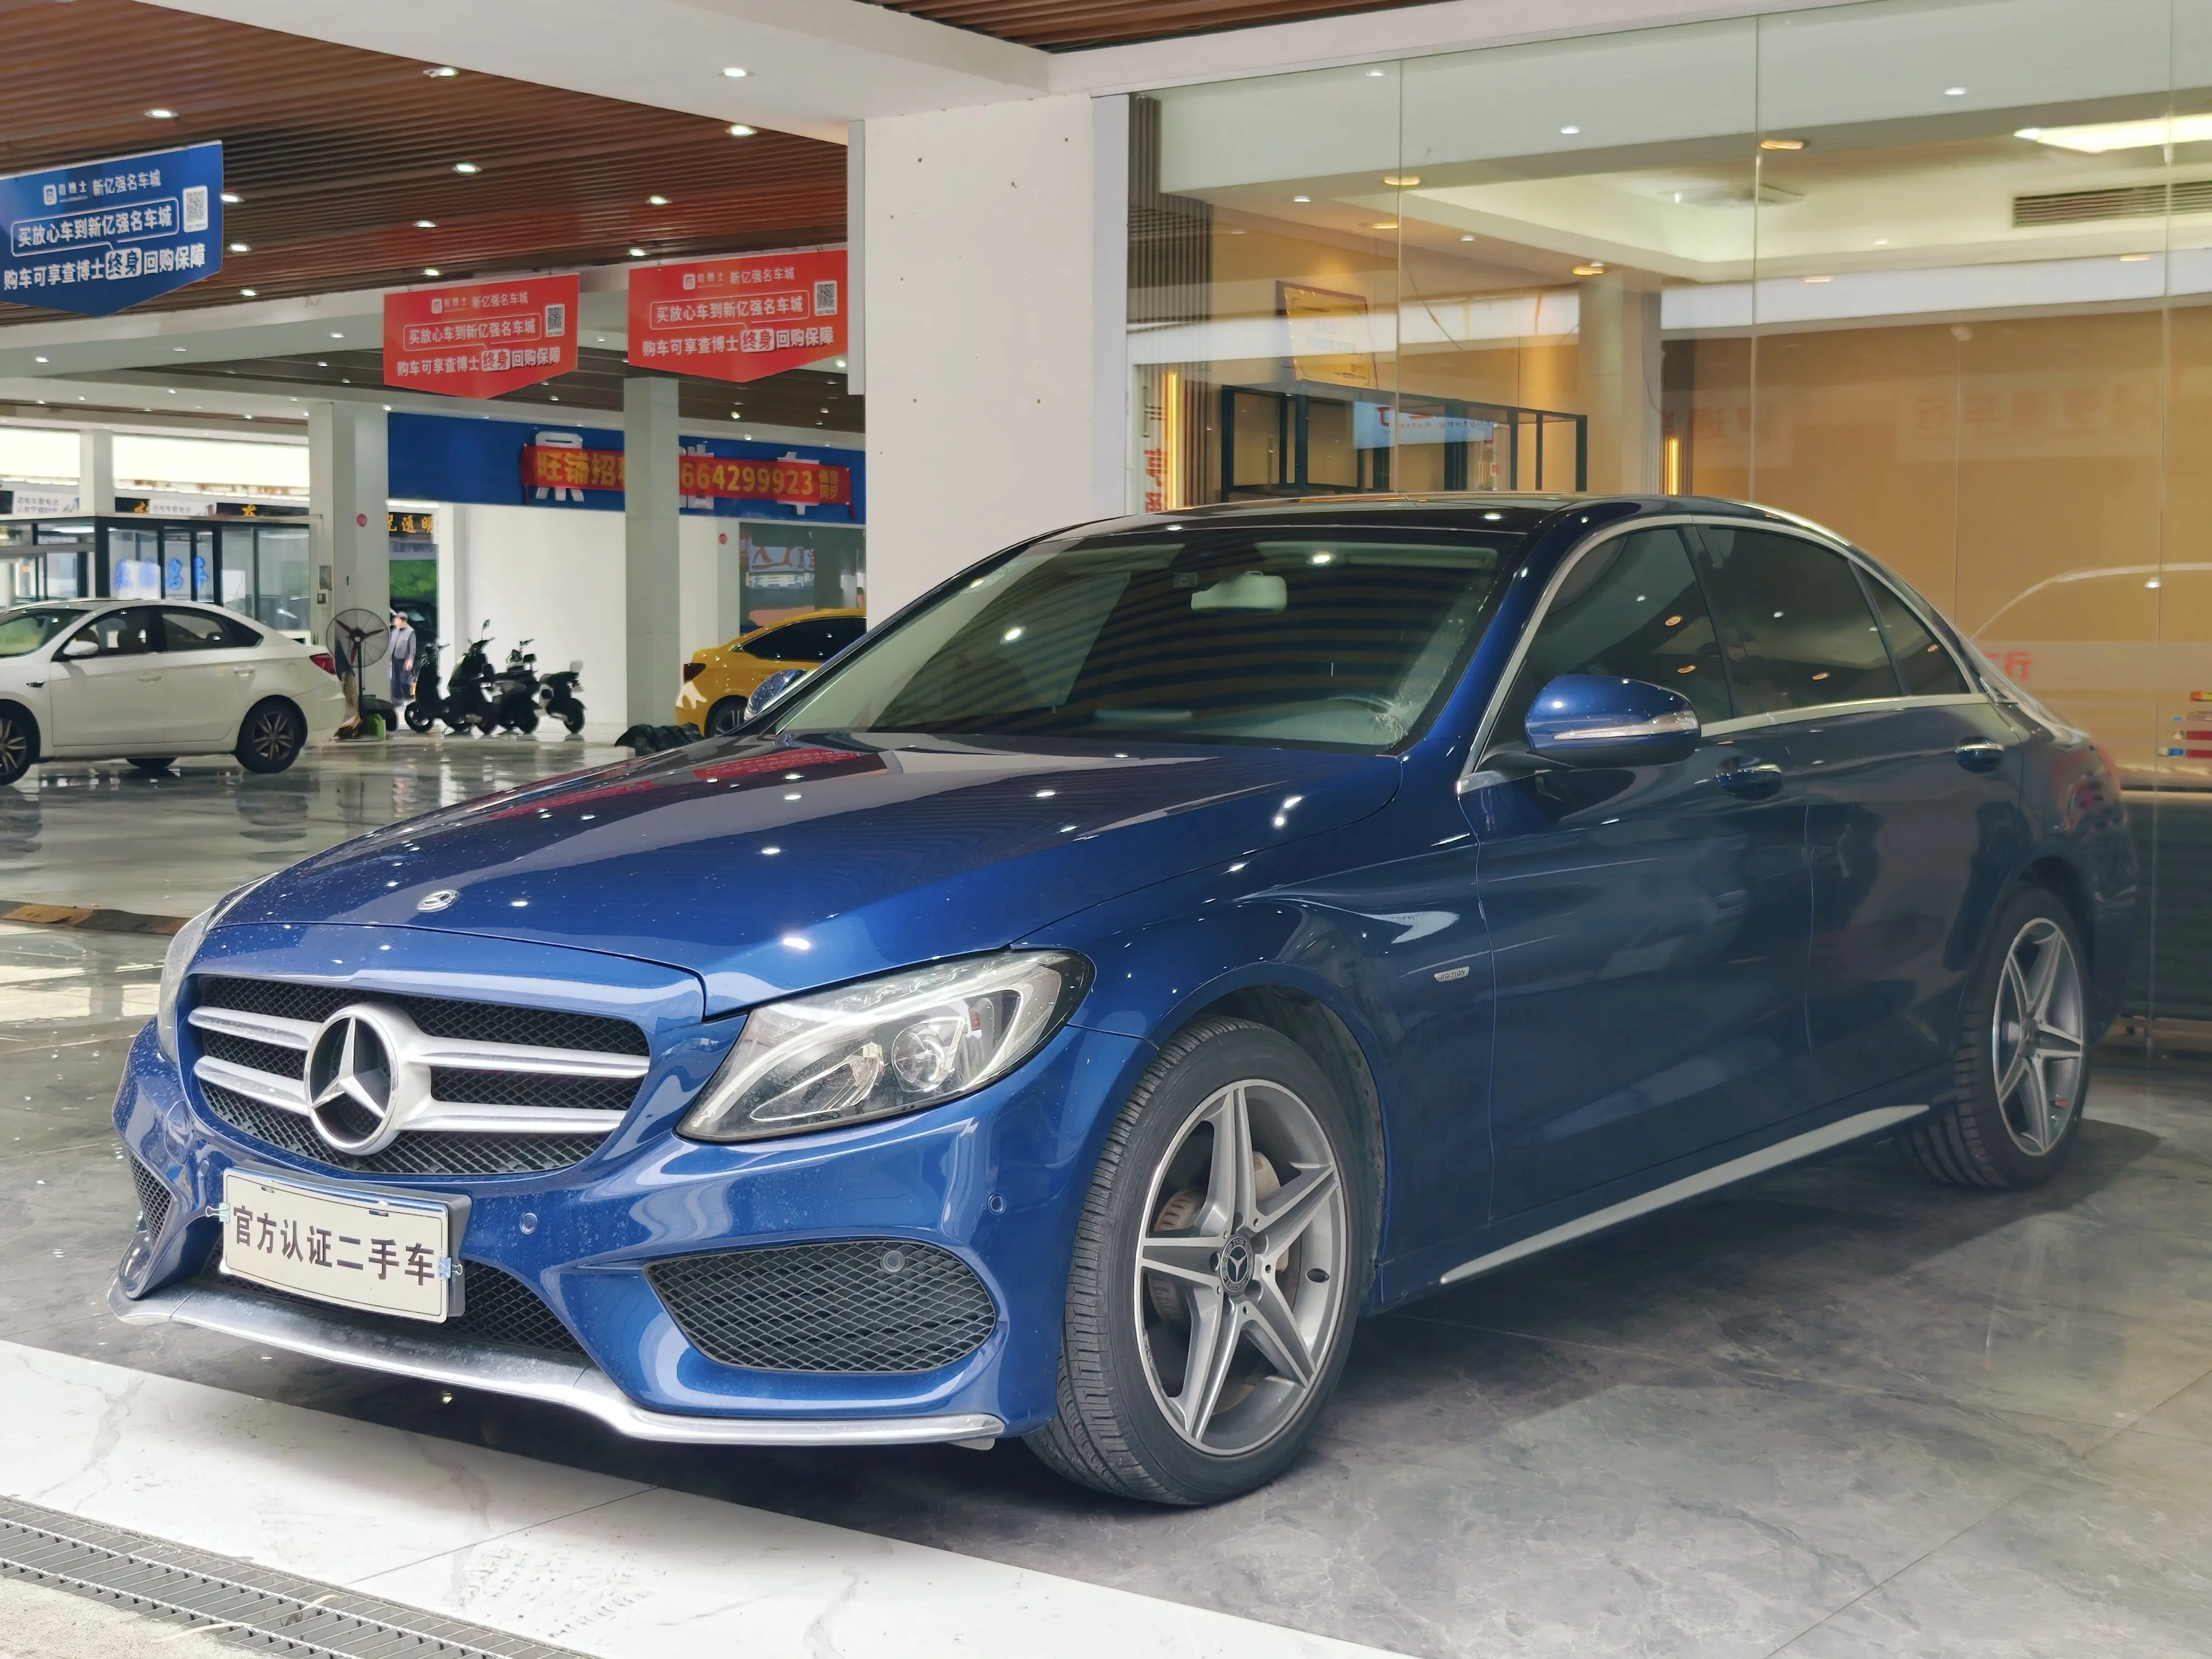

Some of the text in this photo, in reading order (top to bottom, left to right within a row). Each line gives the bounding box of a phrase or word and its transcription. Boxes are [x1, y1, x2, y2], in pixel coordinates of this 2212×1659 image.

[18, 205, 173, 247] 买放心车到新亿强名车城
[4, 242, 206, 291] 购车可享查博士终身回购保障
[656, 295, 804, 322] 买放心车到新亿强名车城
[408, 318, 536, 345] 买放心车到新亿强名车城
[642, 326, 834, 357] 购车可享查博士终身回购保障
[397, 346, 561, 377] 购车可享查博士终身回购保障
[537, 450, 625, 486] 旺铺招
[681, 463, 813, 496] 664299923
[233, 1205, 435, 1286] 官方认证二手车
